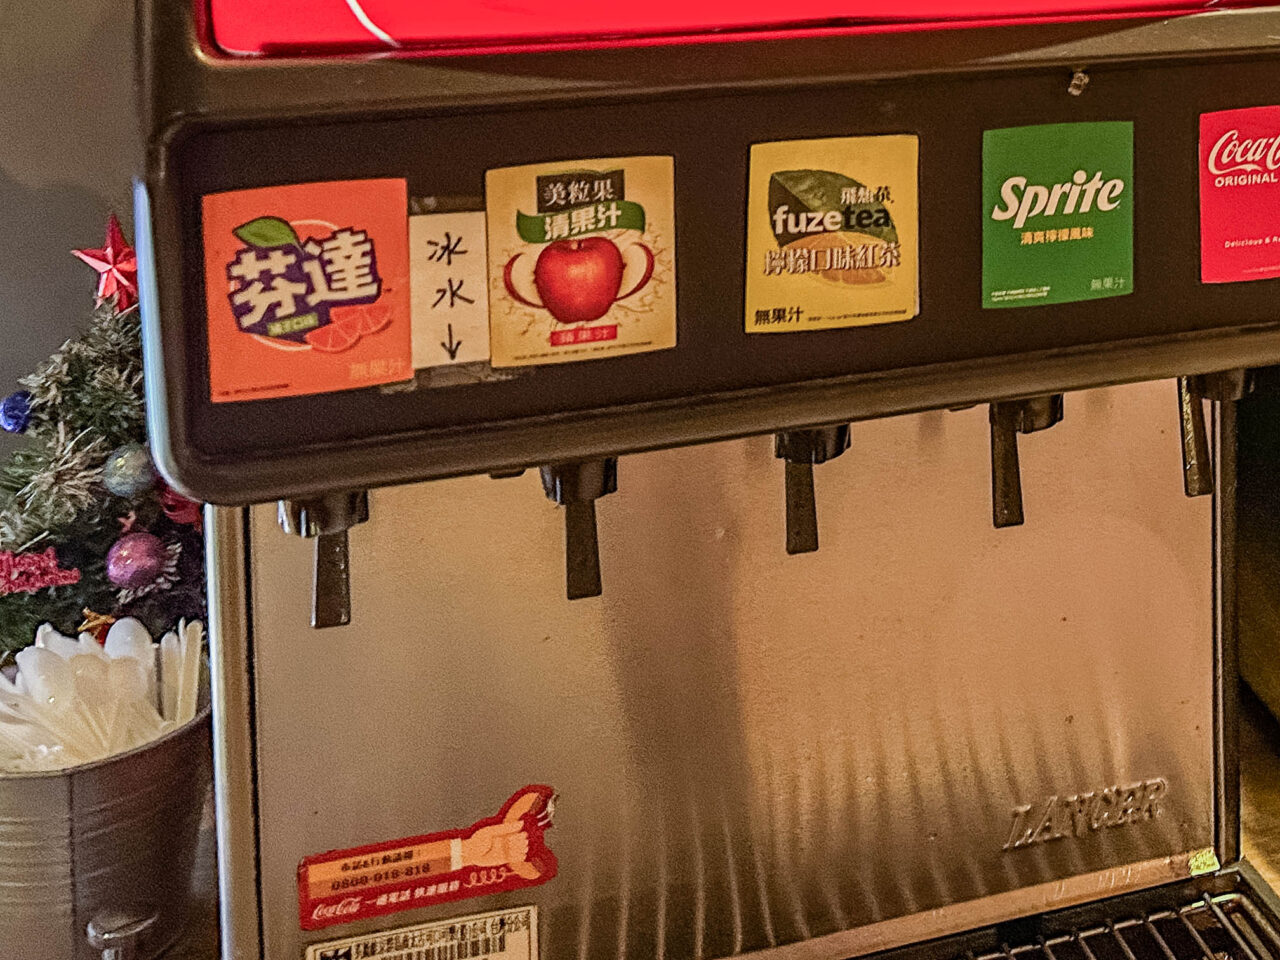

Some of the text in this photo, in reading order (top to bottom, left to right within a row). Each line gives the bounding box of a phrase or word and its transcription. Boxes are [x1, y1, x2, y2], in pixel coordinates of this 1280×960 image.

[1215, 173, 1279, 188] ORIGINAL
[991, 170, 1125, 229] Sprite
[1224, 239, 1263, 248] Delicious
[764, 242, 901, 276] 檸檬口味紅茶
[230, 230, 379, 328] 芬達
[754, 306, 804, 326] 無果汁
